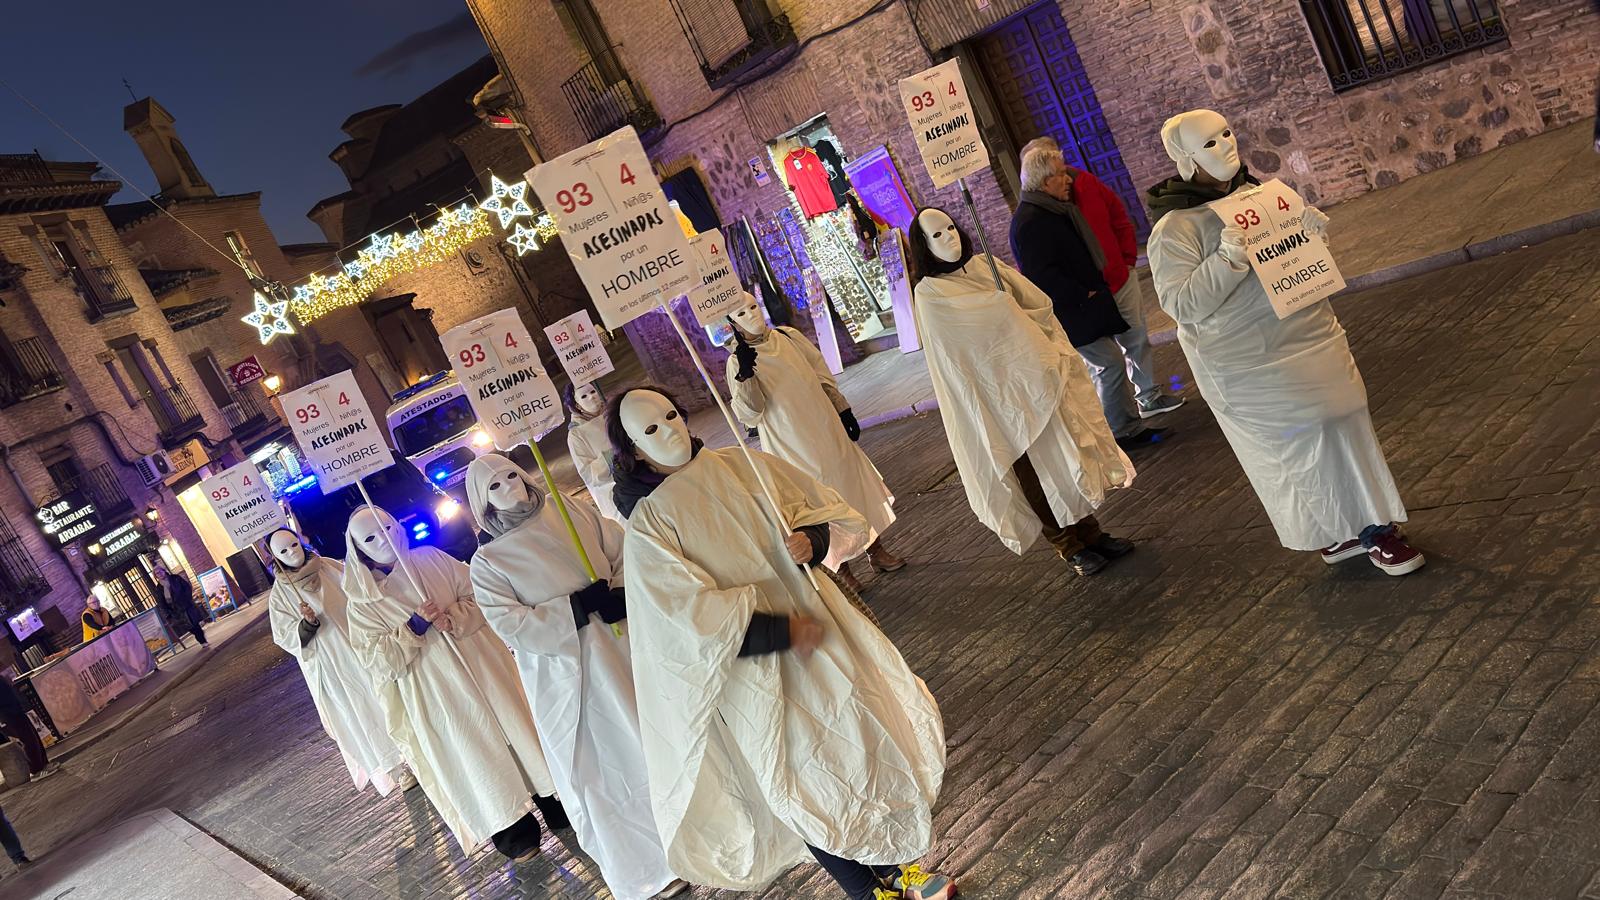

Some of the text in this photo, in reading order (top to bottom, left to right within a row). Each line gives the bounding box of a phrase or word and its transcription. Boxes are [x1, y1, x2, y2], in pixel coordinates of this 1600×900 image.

[911, 81, 957, 112] 93 4
[917, 112, 942, 126] Mujeres
[925, 112, 969, 142] ASESINADAS
[932, 141, 978, 169] HOMBRE
[556, 163, 635, 213] 93 4
[568, 191, 654, 235] Mujeres Niñ@s
[1234, 196, 1290, 230] 93 4
[1280, 215, 1302, 231] Niñ@s
[582, 207, 664, 259] ASESINADAS
[620, 244, 649, 263] por un
[710, 244, 719, 255] 4
[1255, 229, 1310, 264] ASESINADAS
[601, 248, 684, 299] HOMBRE
[702, 265, 729, 286] SINADAS
[1281, 256, 1300, 271] por un
[661, 283, 669, 292] 12
[1271, 259, 1330, 295] HOMBRE
[697, 286, 738, 312] HOMBRE
[554, 331, 569, 345] 93
[577, 323, 585, 333] 4
[459, 332, 518, 368] 93 4
[565, 340, 595, 362] ASESINADAS
[240, 372, 262, 385] REGALOS
[468, 352, 530, 383] Mujeres Niñ@s
[573, 355, 605, 377] HOMBRE
[478, 366, 538, 401] ASESINADAS
[296, 391, 351, 424] 93 4
[401, 391, 453, 423] ATESTADOS
[503, 390, 525, 406] por un
[492, 394, 553, 430] HOMBRE
[302, 421, 330, 437] Mujeres
[311, 418, 368, 451] ASESINADAS
[321, 443, 380, 474] HOMBRE
[335, 440, 355, 453] por un
[211, 475, 252, 501] 93 4
[51, 501, 70, 516] BAR
[225, 494, 266, 520] ASESINADAS
[57, 520, 96, 544] ARRABAL
[99, 521, 134, 545] RESTAURANTE
[233, 510, 277, 536] HOMBRE
[105, 530, 141, 556] ARRABAL
